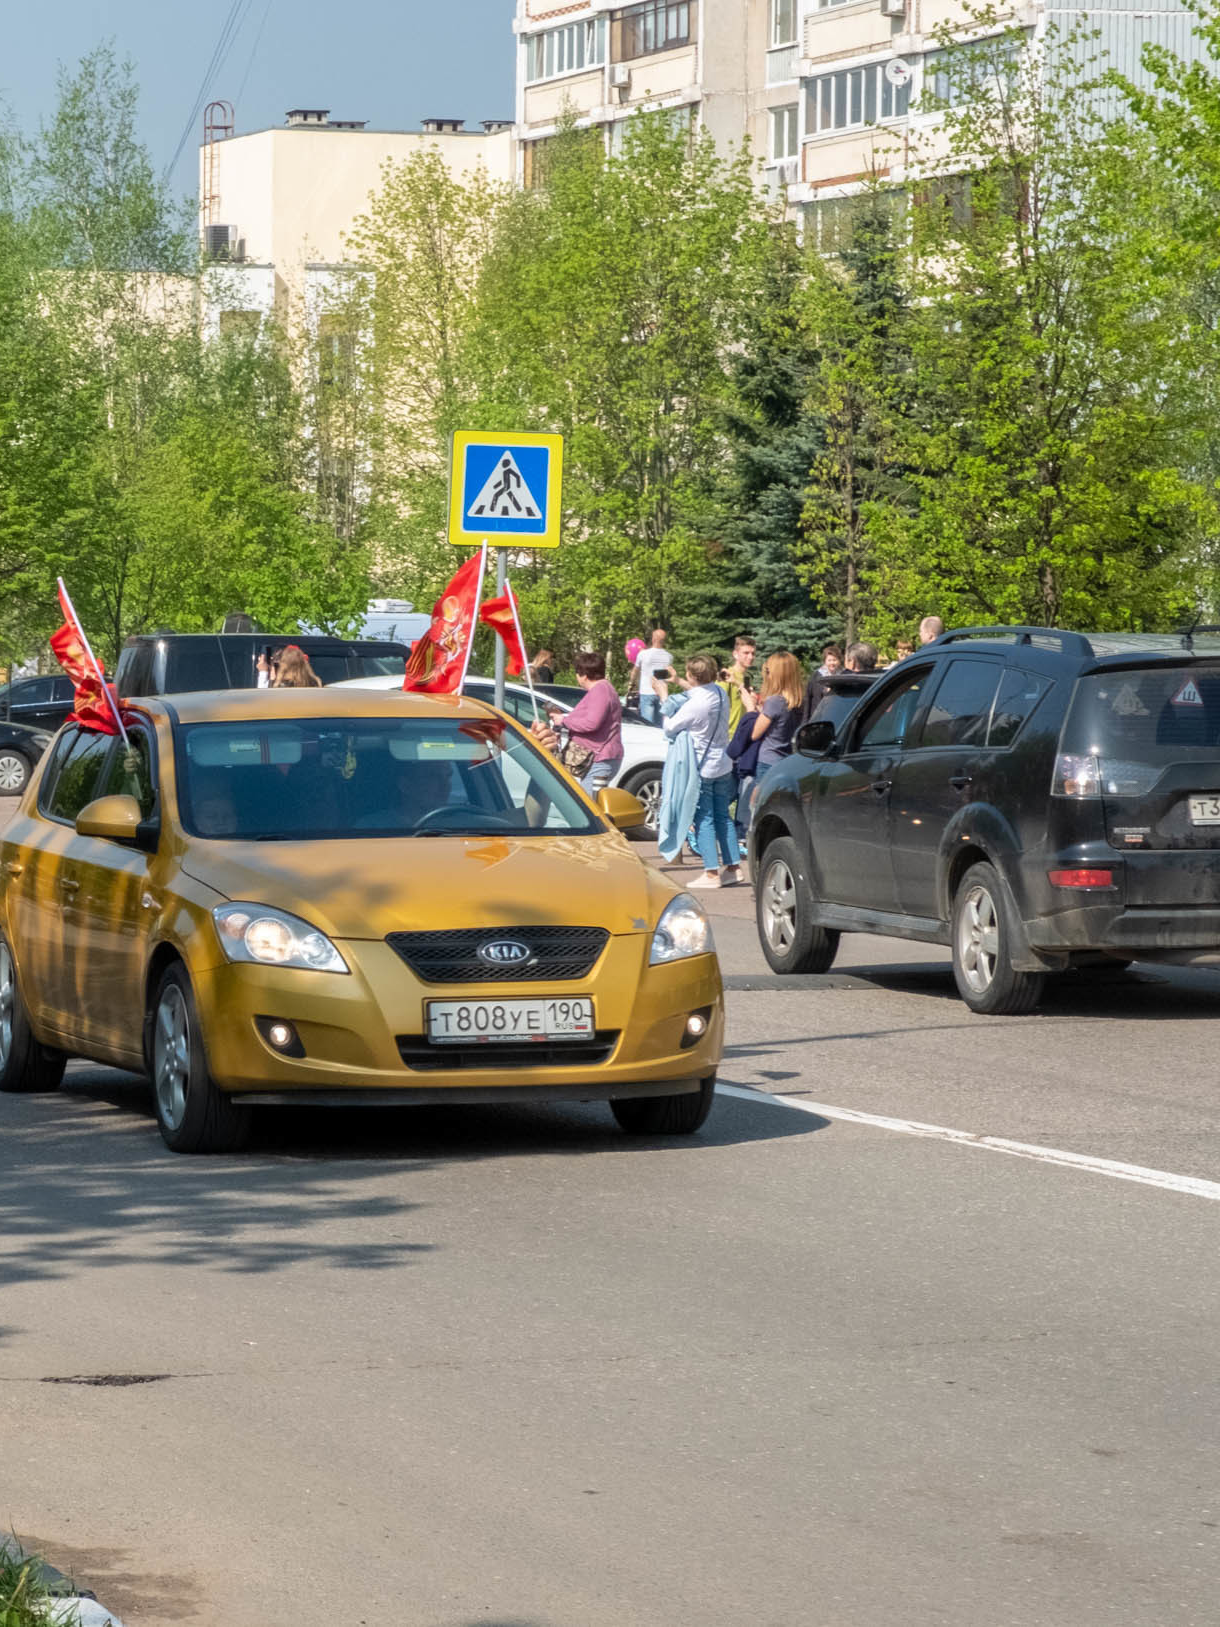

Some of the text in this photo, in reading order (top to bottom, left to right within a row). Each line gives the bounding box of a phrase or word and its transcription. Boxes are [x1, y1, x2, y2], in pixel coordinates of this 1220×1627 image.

[1182, 690, 1196, 702] Ш
[489, 945, 522, 959] KIA
[440, 1001, 584, 1033] Т808УЕ 190
